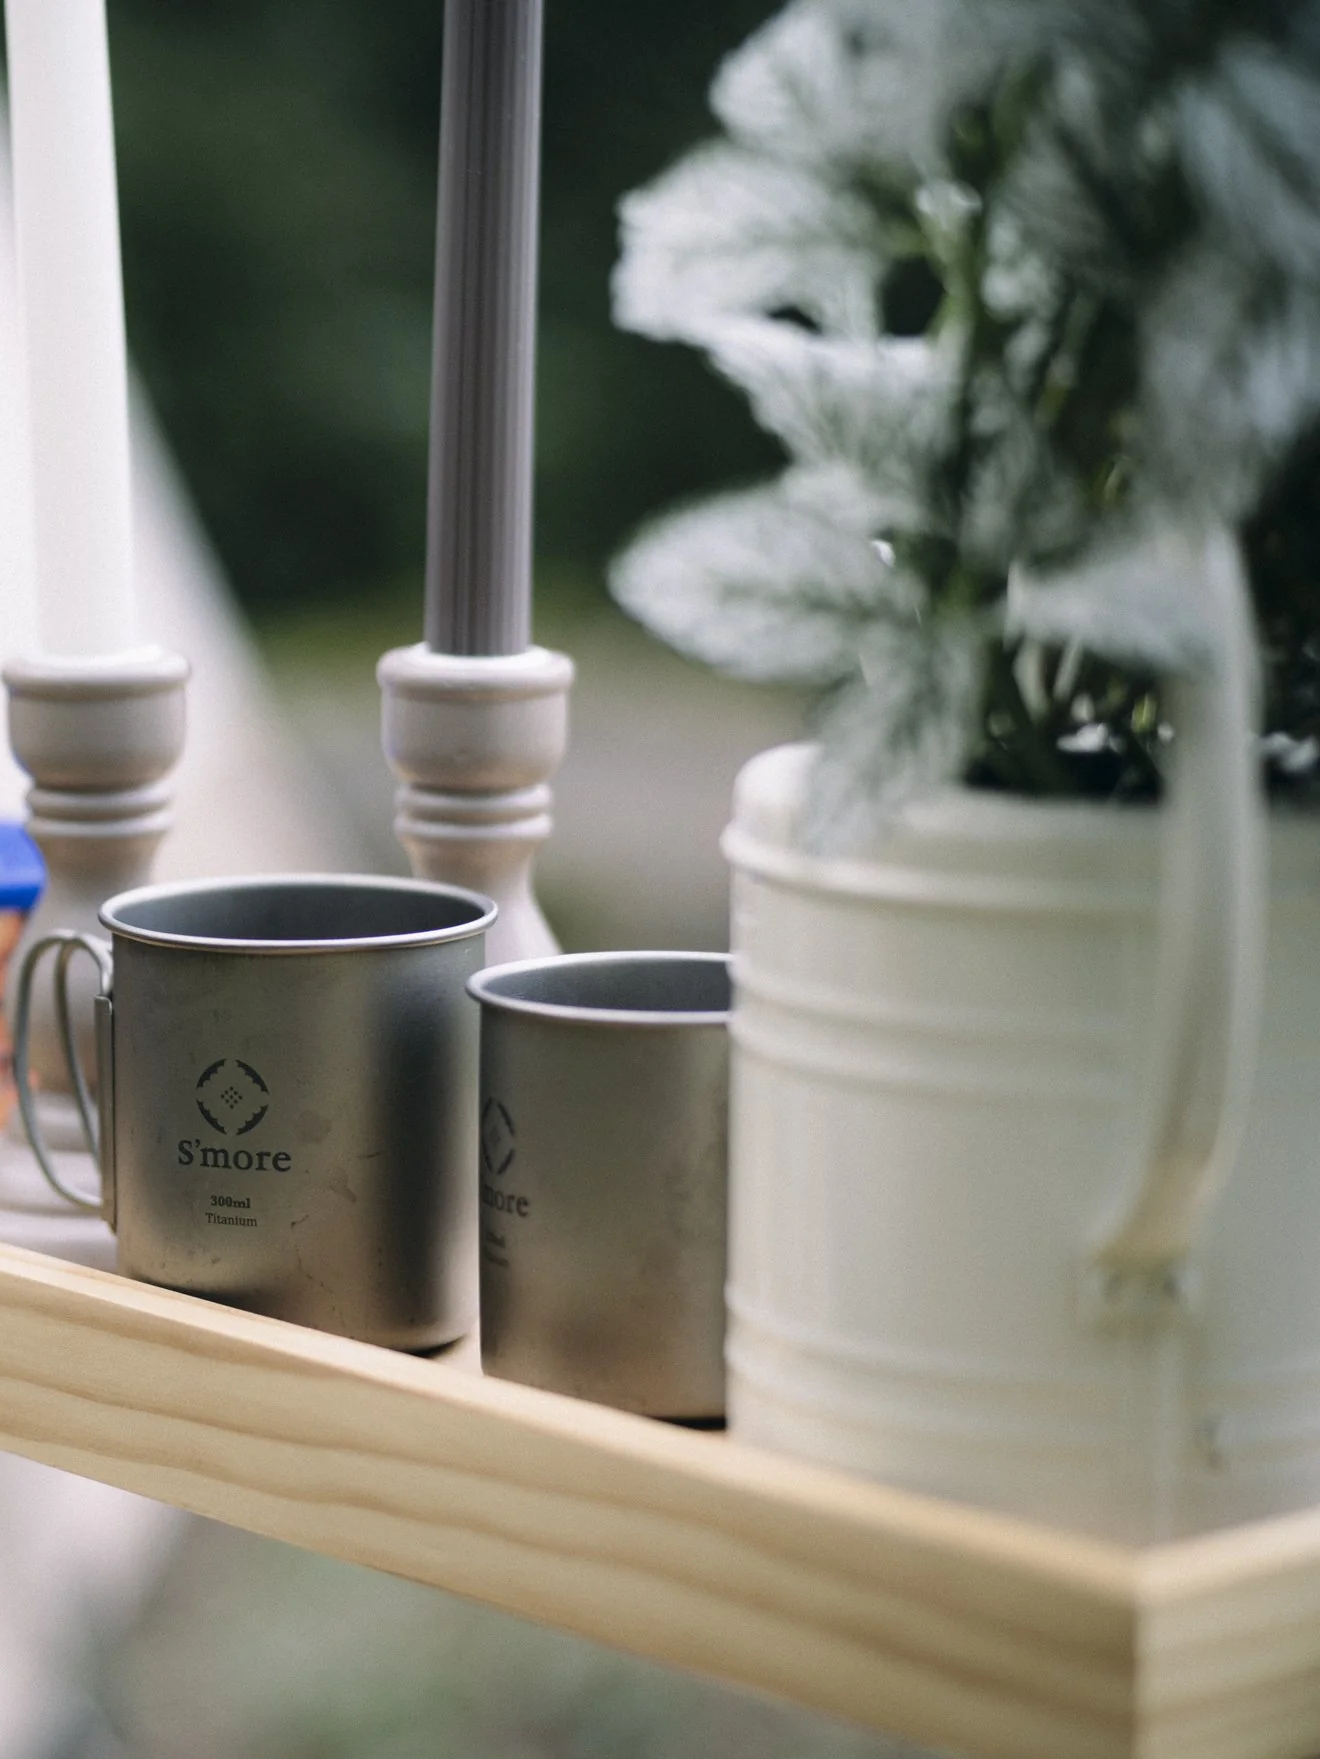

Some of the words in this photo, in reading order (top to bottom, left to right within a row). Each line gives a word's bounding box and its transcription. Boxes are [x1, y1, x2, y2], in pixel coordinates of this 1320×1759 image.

[178, 1139, 292, 1173] S'more
[210, 1195, 251, 1209] 300ml
[483, 1184, 530, 1217] more
[205, 1213, 258, 1227] Titanium
